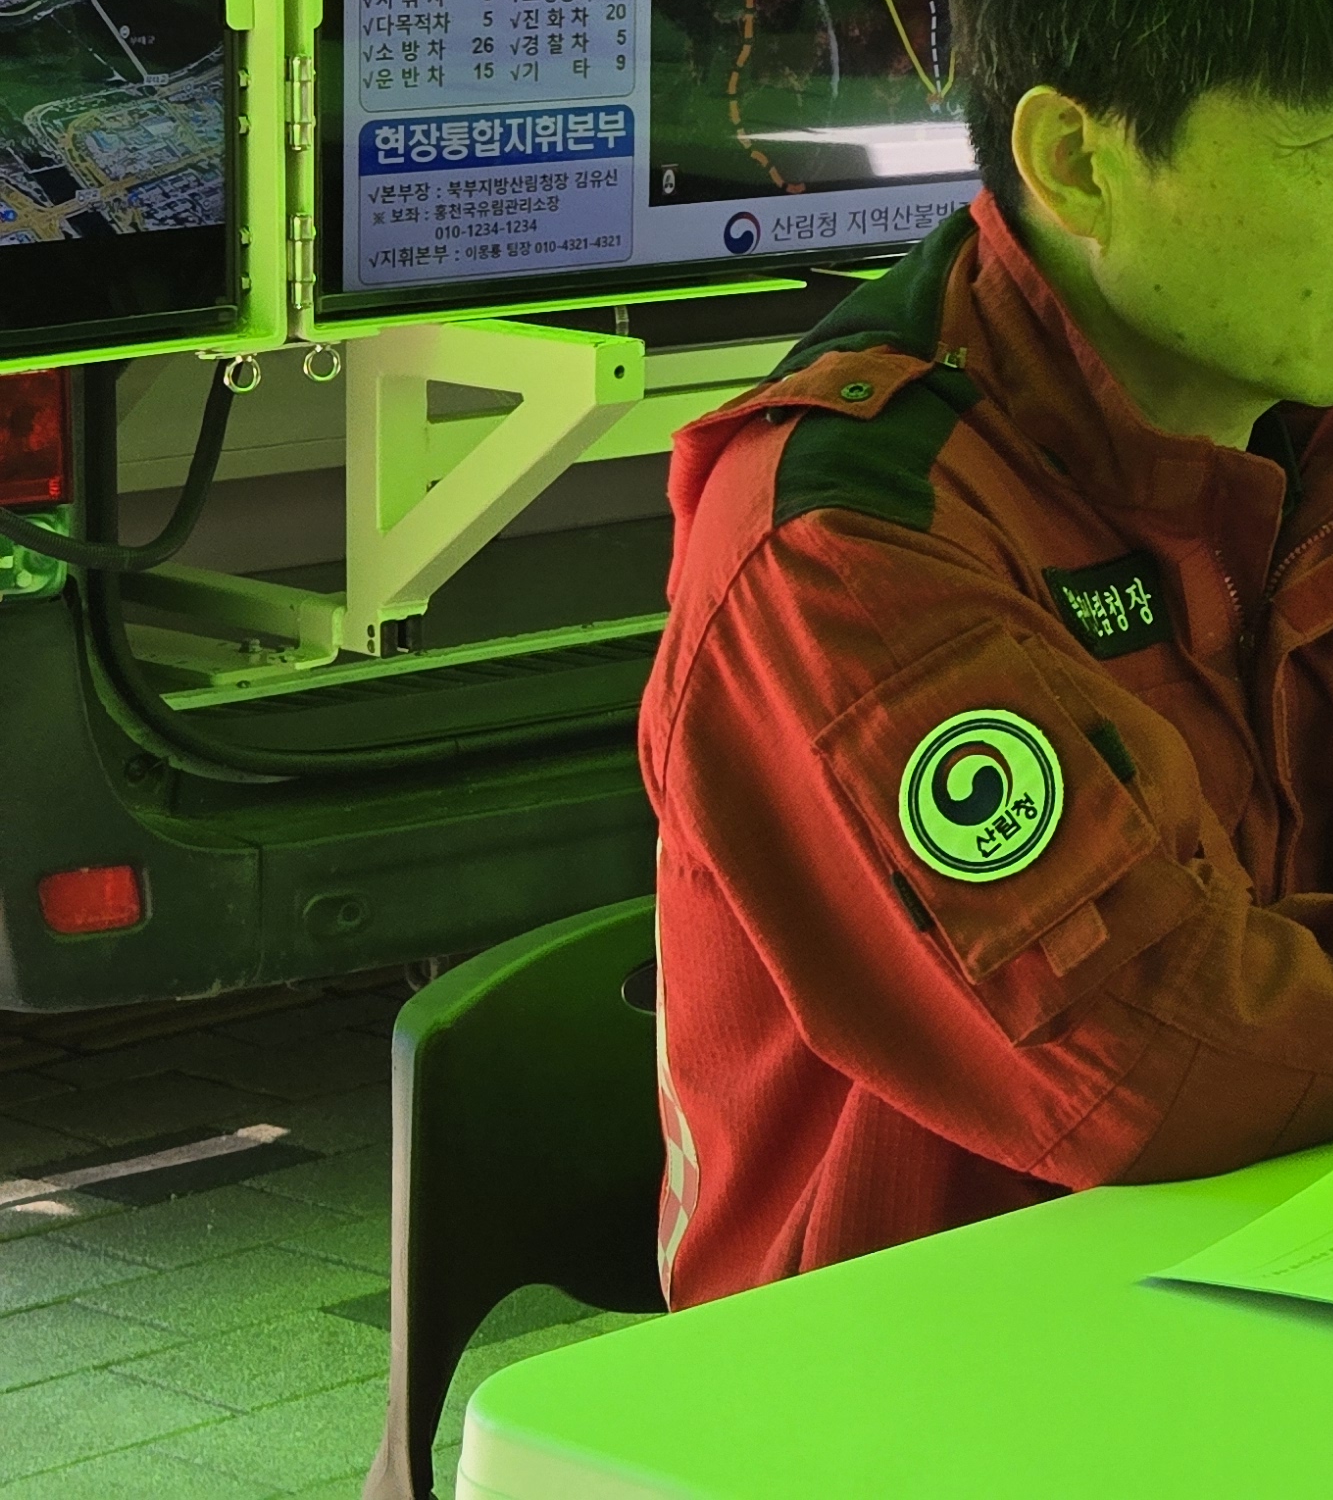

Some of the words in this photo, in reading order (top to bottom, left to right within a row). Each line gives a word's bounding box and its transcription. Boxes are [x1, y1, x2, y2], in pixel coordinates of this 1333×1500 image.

[376, 12, 450, 36] 다목적차
[483, 12, 492, 27] 5
[606, 4, 626, 21] 20
[472, 37, 494, 54] 26
[617, 30, 626, 45] 5
[474, 62, 494, 80] 15
[616, 54, 625, 70] 9
[374, 110, 626, 165] 현장통합지휘본부
[382, 182, 430, 204] 본부장
[447, 173, 568, 199] 북부지방산림청장
[575, 168, 618, 189] 김유신
[391, 208, 419, 224] 보좌
[434, 196, 559, 221] 홍천국유림관리소장
[772, 210, 836, 242] 산림청
[847, 200, 968, 235] 지역산불방
[435, 219, 537, 240] 010-1234-1234
[382, 243, 449, 268] 지휘본부
[507, 240, 530, 258] 팀장
[535, 235, 621, 254] 010-4321-4321
[976, 792, 1037, 858] 산림청
